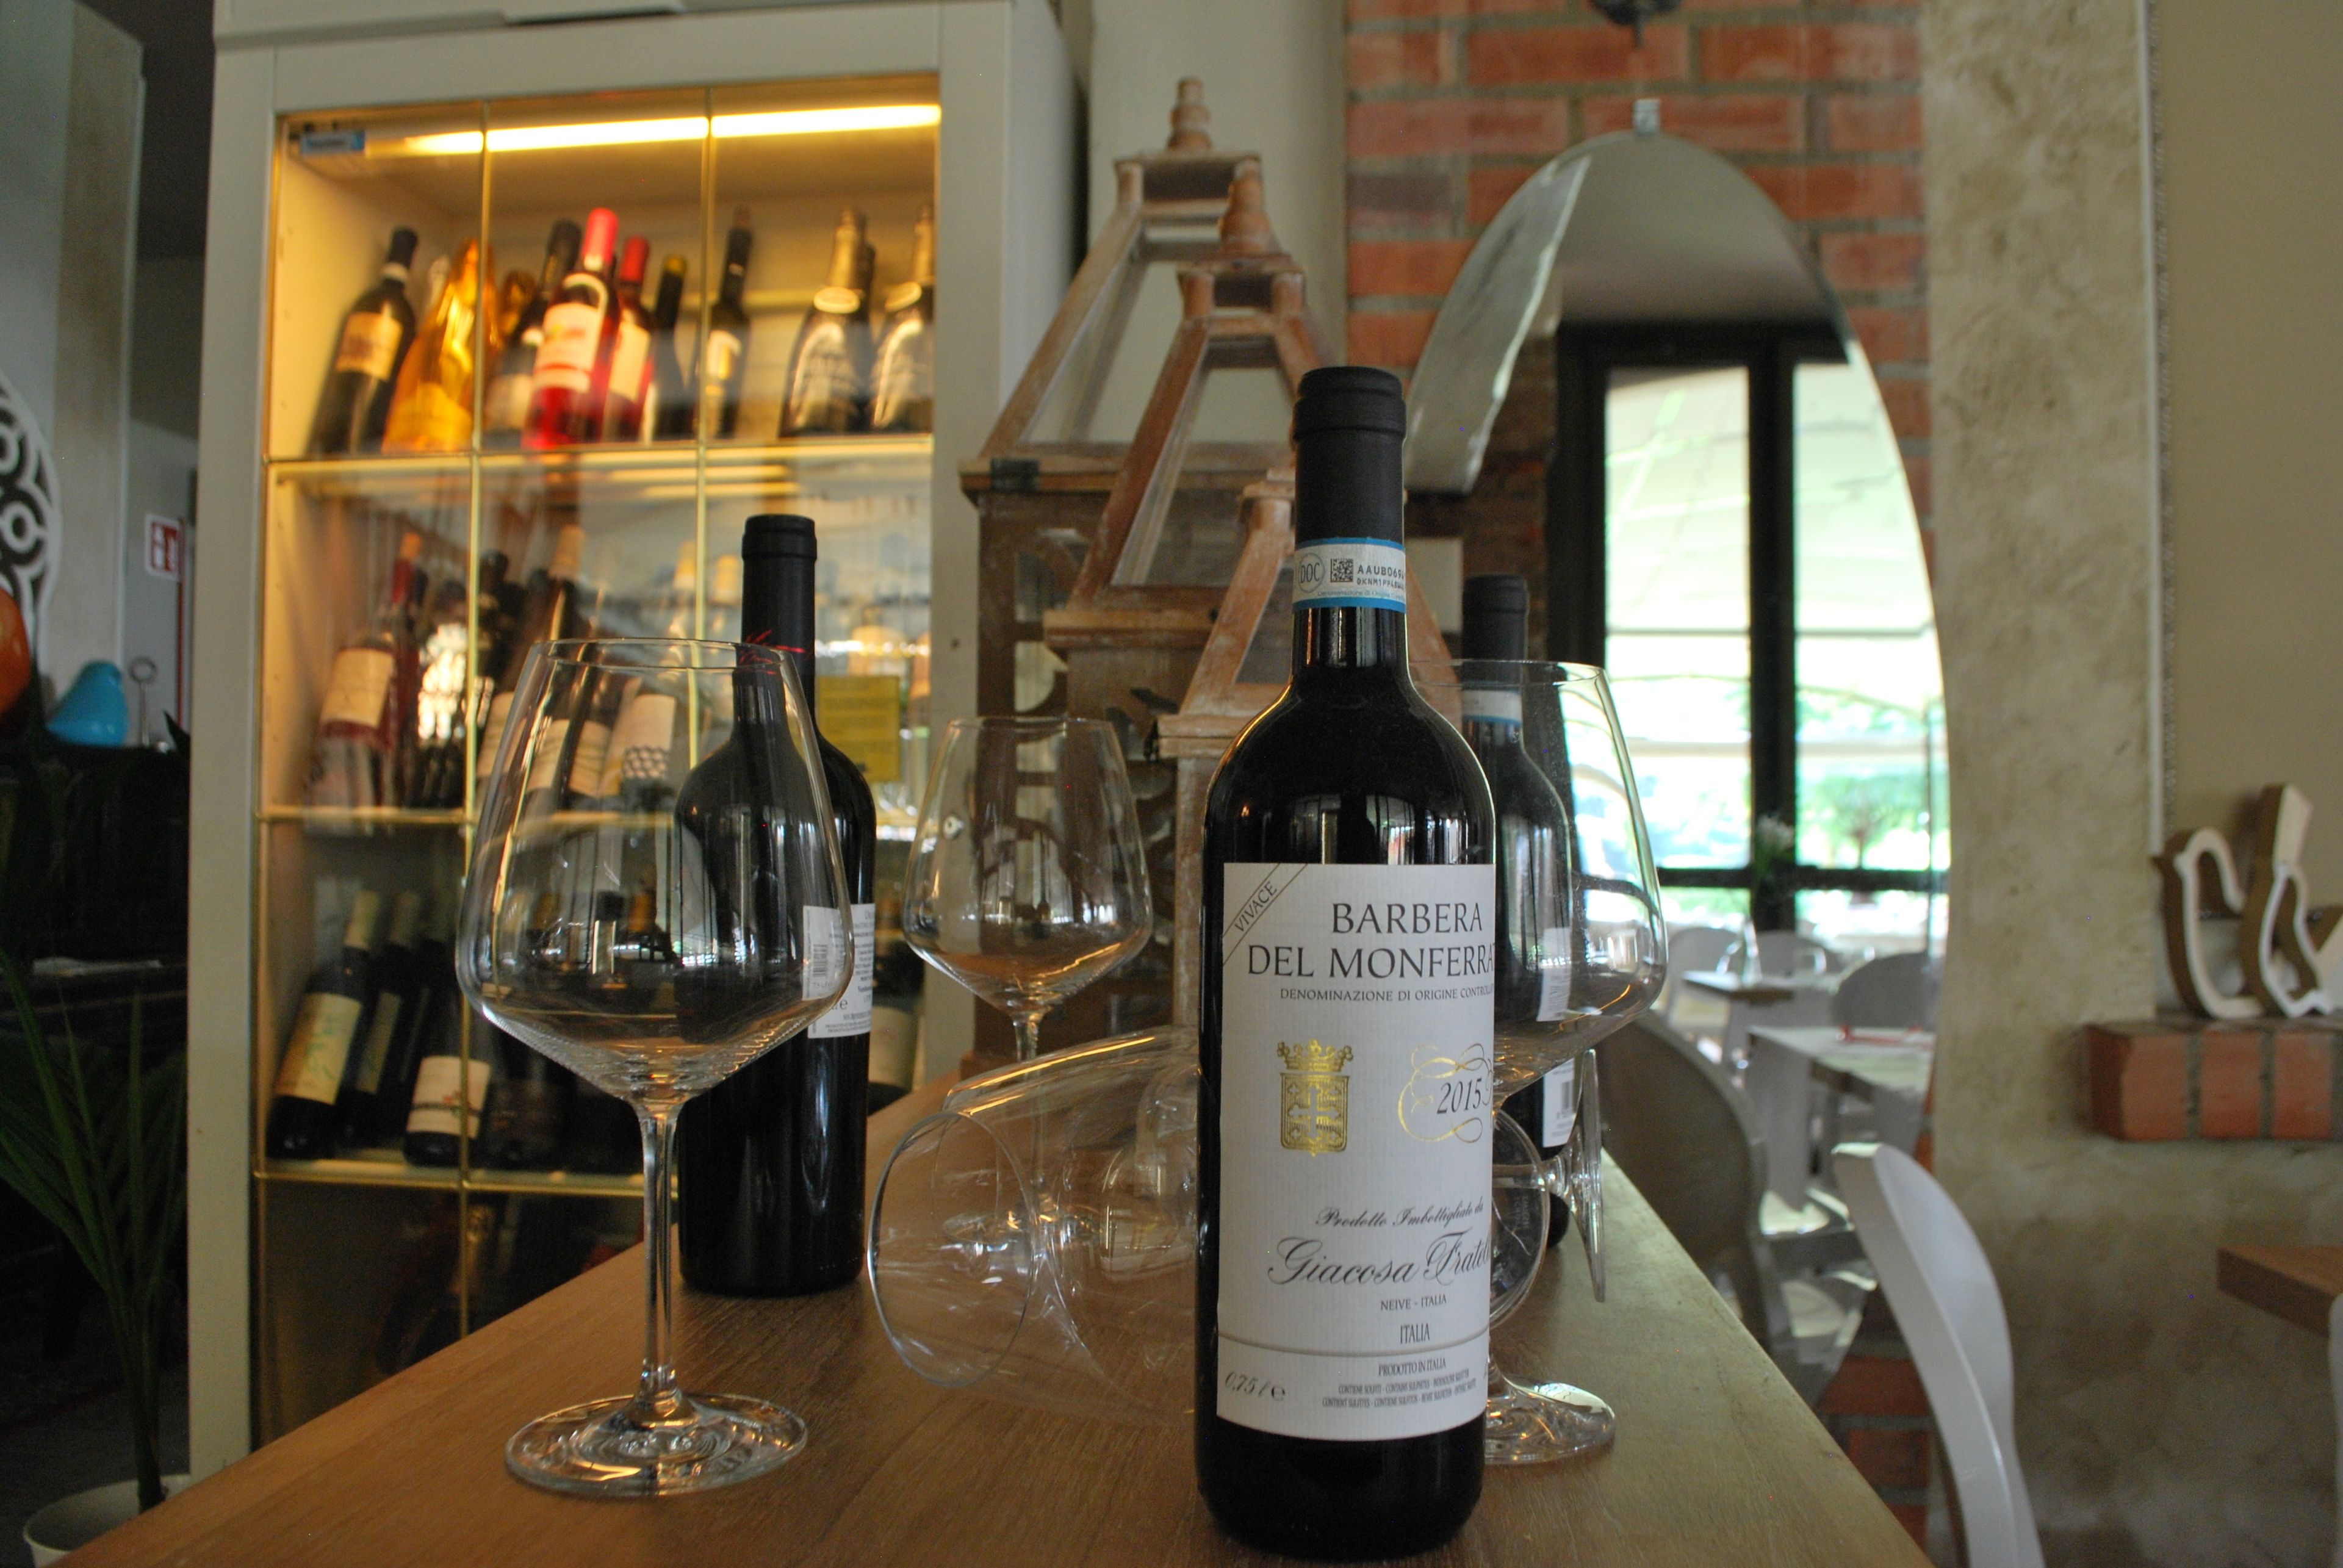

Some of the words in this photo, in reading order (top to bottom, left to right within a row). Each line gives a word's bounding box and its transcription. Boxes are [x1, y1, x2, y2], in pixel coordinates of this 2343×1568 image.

[1300, 562, 1320, 584] DOC
[1234, 880, 1278, 932] VIVACE
[1332, 902, 1483, 935] BARBERA
[1248, 944, 1314, 977] DEL
[1280, 987, 1394, 1002] DENOMINAZIONE
[1398, 989, 1411, 1001] DI
[1415, 988, 1458, 1002] ORIGINE
[1436, 1077, 1483, 1115] 2015
[1315, 1207, 1387, 1228] Prodotto
[1267, 1236, 1420, 1286] Giacosa
[1380, 1297, 1411, 1311] NEIVE
[1420, 1294, 1447, 1309] ITALIA
[1400, 1323, 1430, 1344] ITALIA
[1378, 1362, 1417, 1376] PRODOTTO
[1418, 1361, 1426, 1373] IN
[1427, 1358, 1447, 1372] ITALIA
